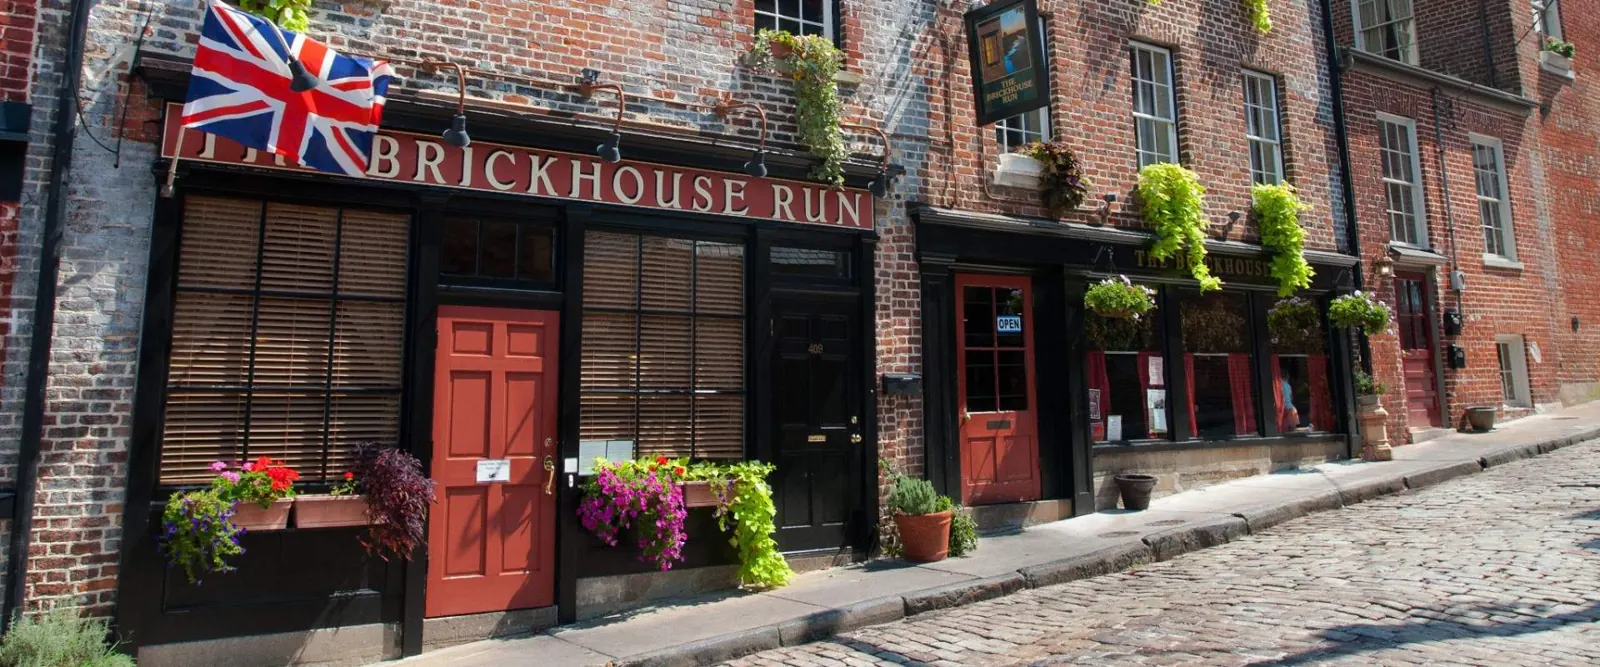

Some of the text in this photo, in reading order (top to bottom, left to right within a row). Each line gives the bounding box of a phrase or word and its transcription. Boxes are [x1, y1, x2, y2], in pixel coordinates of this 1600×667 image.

[1001, 78, 1016, 88] THE
[986, 79, 1033, 101] BRICKHOUSE
[1002, 93, 1017, 104] RUN
[366, 134, 750, 217] BRICKHOUSE
[770, 183, 863, 227] RUN
[999, 318, 1020, 330] OPEN
[807, 343, 824, 354] 409
